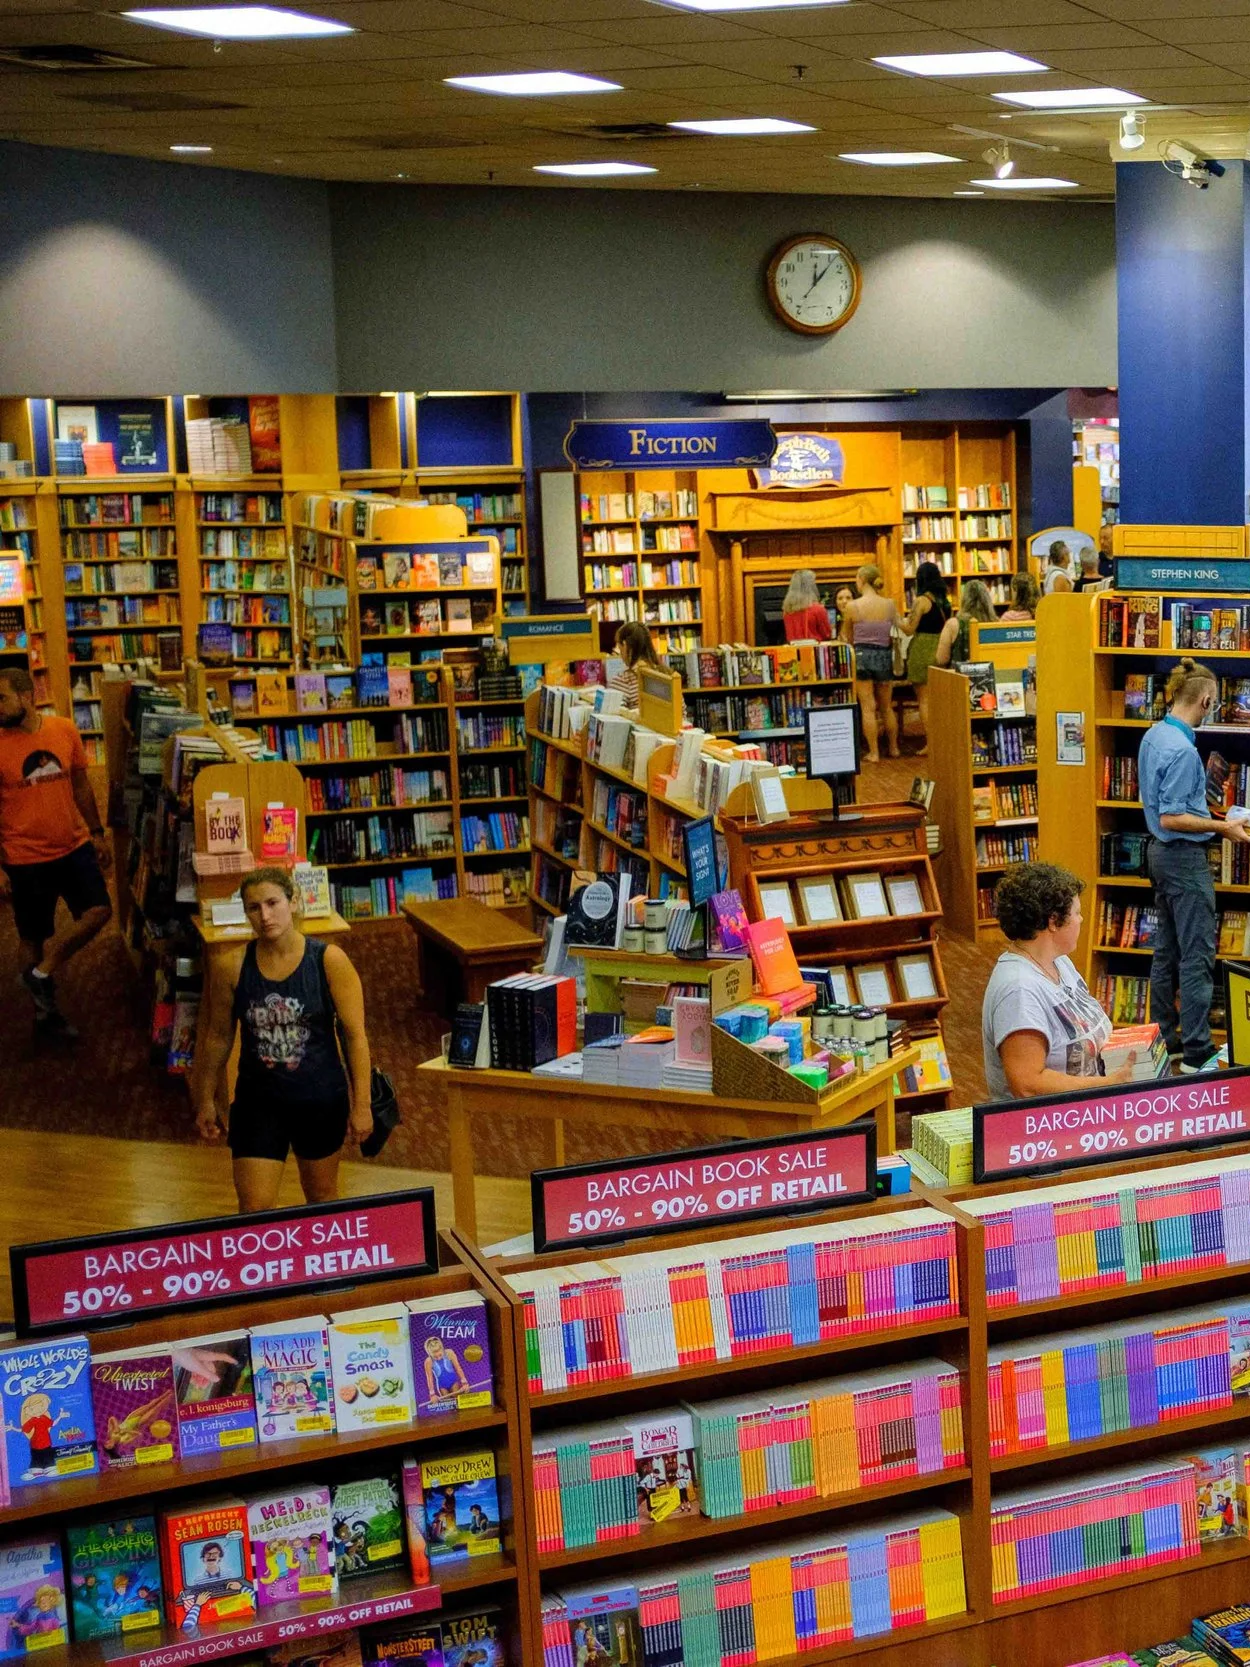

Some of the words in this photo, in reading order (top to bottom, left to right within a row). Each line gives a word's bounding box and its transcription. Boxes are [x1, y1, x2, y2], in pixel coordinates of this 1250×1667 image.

[628, 429, 717, 455] FICTION
[1151, 569, 1192, 579] STEPHEN
[1194, 570, 1219, 579] KING
[1128, 603, 1159, 613] KING
[528, 624, 564, 633] ROMANCE
[1006, 630, 1021, 639] STAR
[209, 817, 221, 828] BY
[224, 815, 240, 825] THE
[210, 827, 240, 840] BOOK
[695, 858, 708, 868] YOUR
[714, 891, 740, 908] LOVE
[1025, 1103, 1116, 1134] BARGAIN
[1124, 1094, 1181, 1119] BOOK
[1188, 1086, 1229, 1108] SALE
[1009, 1140, 1057, 1164] 50%
[1080, 1130, 1128, 1152] 90%
[1135, 1123, 1174, 1143] OFF
[1182, 1111, 1246, 1136] RETAIL
[588, 1166, 693, 1202] BARGAIN
[702, 1156, 770, 1183] BOOK
[778, 1148, 827, 1172] SALE
[568, 1207, 625, 1234] 50%
[652, 1194, 708, 1220] 90%
[716, 1186, 761, 1209] OFF
[771, 1172, 848, 1201] RETAIL
[84, 1239, 212, 1278] BARGAIN
[222, 1226, 302, 1258] BOOK
[312, 1216, 368, 1244] SALE
[63, 1283, 132, 1314] 50%
[163, 1267, 231, 1298] 90%
[240, 1259, 294, 1286] OFF
[305, 1244, 394, 1276] RETAIL
[424, 1313, 478, 1330] Winning
[440, 1326, 475, 1339] TEAM
[259, 1339, 289, 1356] JUST
[290, 1336, 316, 1349] ADD
[358, 1341, 376, 1349] The
[264, 1349, 318, 1368] MAGIC
[347, 1348, 389, 1362] Candy
[3, 1355, 40, 1373] WHOLE
[345, 1359, 394, 1376] Smash
[115, 1377, 157, 1391] TWIST
[197, 1398, 249, 1413] konigsburg
[181, 1424, 199, 1437] My
[201, 1418, 238, 1432] Father's
[463, 1457, 492, 1472] DREW
[175, 1525, 204, 1541] SEAN
[208, 1518, 243, 1534] ROSEN
[449, 1615, 488, 1629] TOM
[139, 1648, 195, 1667] BARGAIN
[198, 1639, 234, 1656] BOOK
[237, 1631, 264, 1648] SALE
[278, 1622, 306, 1638] 50%
[318, 1613, 346, 1628] 90%
[349, 1605, 372, 1621] OFF
[375, 1599, 413, 1614] RETAIL
[443, 1626, 496, 1648] SWIFT
